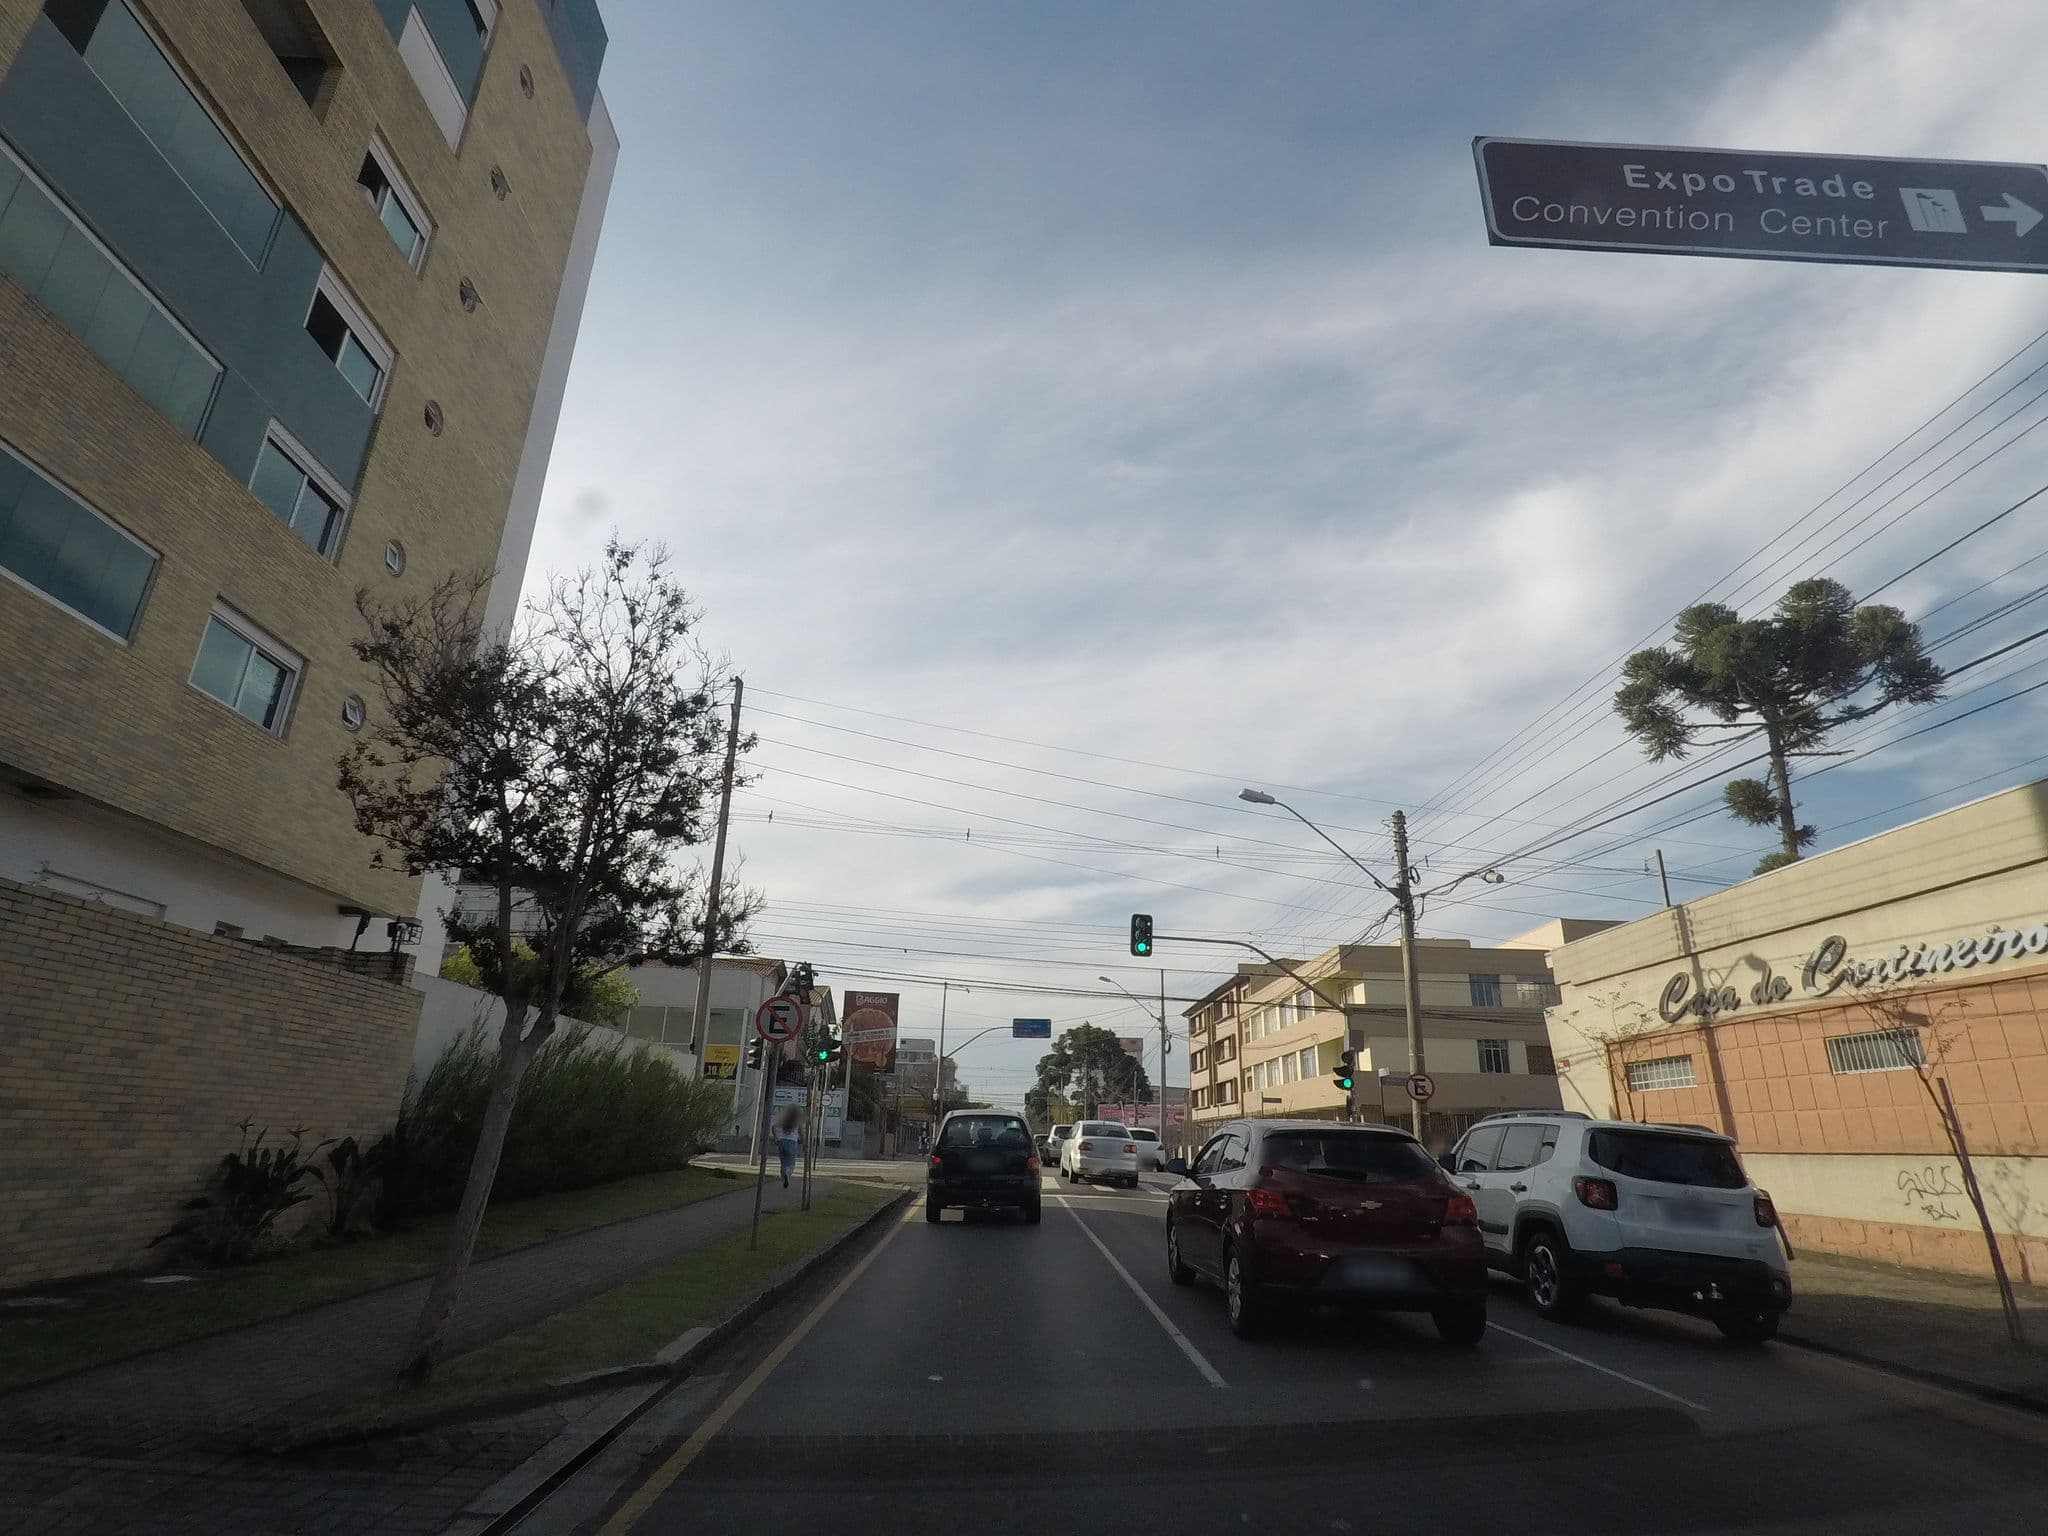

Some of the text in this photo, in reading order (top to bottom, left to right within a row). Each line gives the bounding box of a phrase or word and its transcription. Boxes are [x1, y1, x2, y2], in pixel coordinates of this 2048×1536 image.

[1511, 195, 1889, 240] Convention Center
[855, 994, 889, 1006] BAGGIO
[1659, 971, 1742, 1023] Casa
[768, 1005, 791, 1034] E
